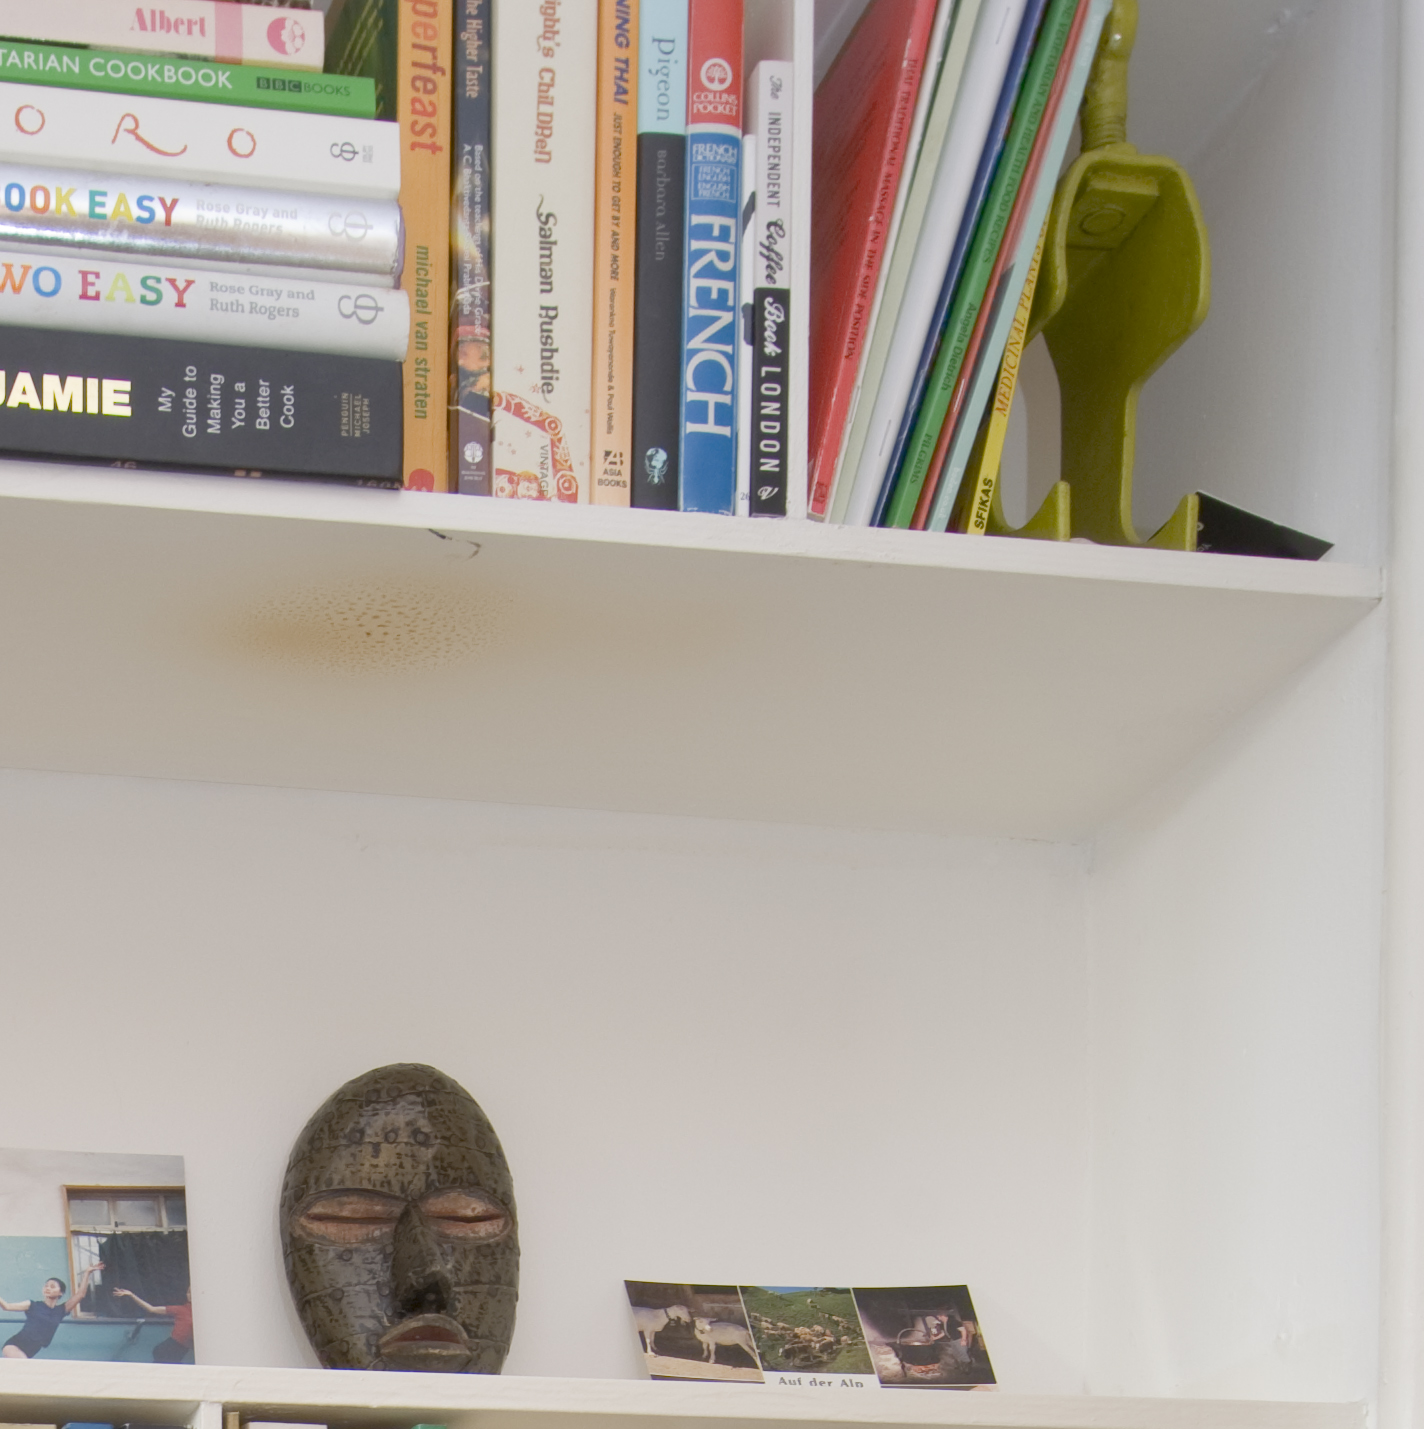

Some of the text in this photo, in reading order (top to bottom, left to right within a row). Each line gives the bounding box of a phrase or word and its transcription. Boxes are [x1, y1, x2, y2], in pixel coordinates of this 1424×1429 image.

[130, 8, 206, 38] Albert
[89, 58, 232, 90] COOKBOOK
[693, 92, 738, 116] COLLINS POCKET
[767, 112, 782, 207] INDEPENDENT
[88, 189, 179, 227] EASY
[759, 218, 785, 284] Coffee
[78, 269, 195, 308] EASY
[209, 281, 316, 301] Rose Gray and
[209, 299, 299, 320] Ruth Rogers
[536, 194, 559, 404] Salman Rushdie
[415, 245, 433, 419] michael van straten
[685, 213, 736, 438] FRENCH
[764, 297, 785, 356] Book
[158, 387, 176, 412] My
[182, 365, 197, 438] Guide to
[207, 373, 225, 434] Making
[232, 381, 245, 430] You a
[256, 379, 271, 430] Better
[280, 385, 295, 429] Cook
[760, 366, 781, 472] LONDON
[973, 478, 994, 530] SFIKAS
[778, 1377, 804, 1387] Auf
[809, 1378, 832, 1388] der
